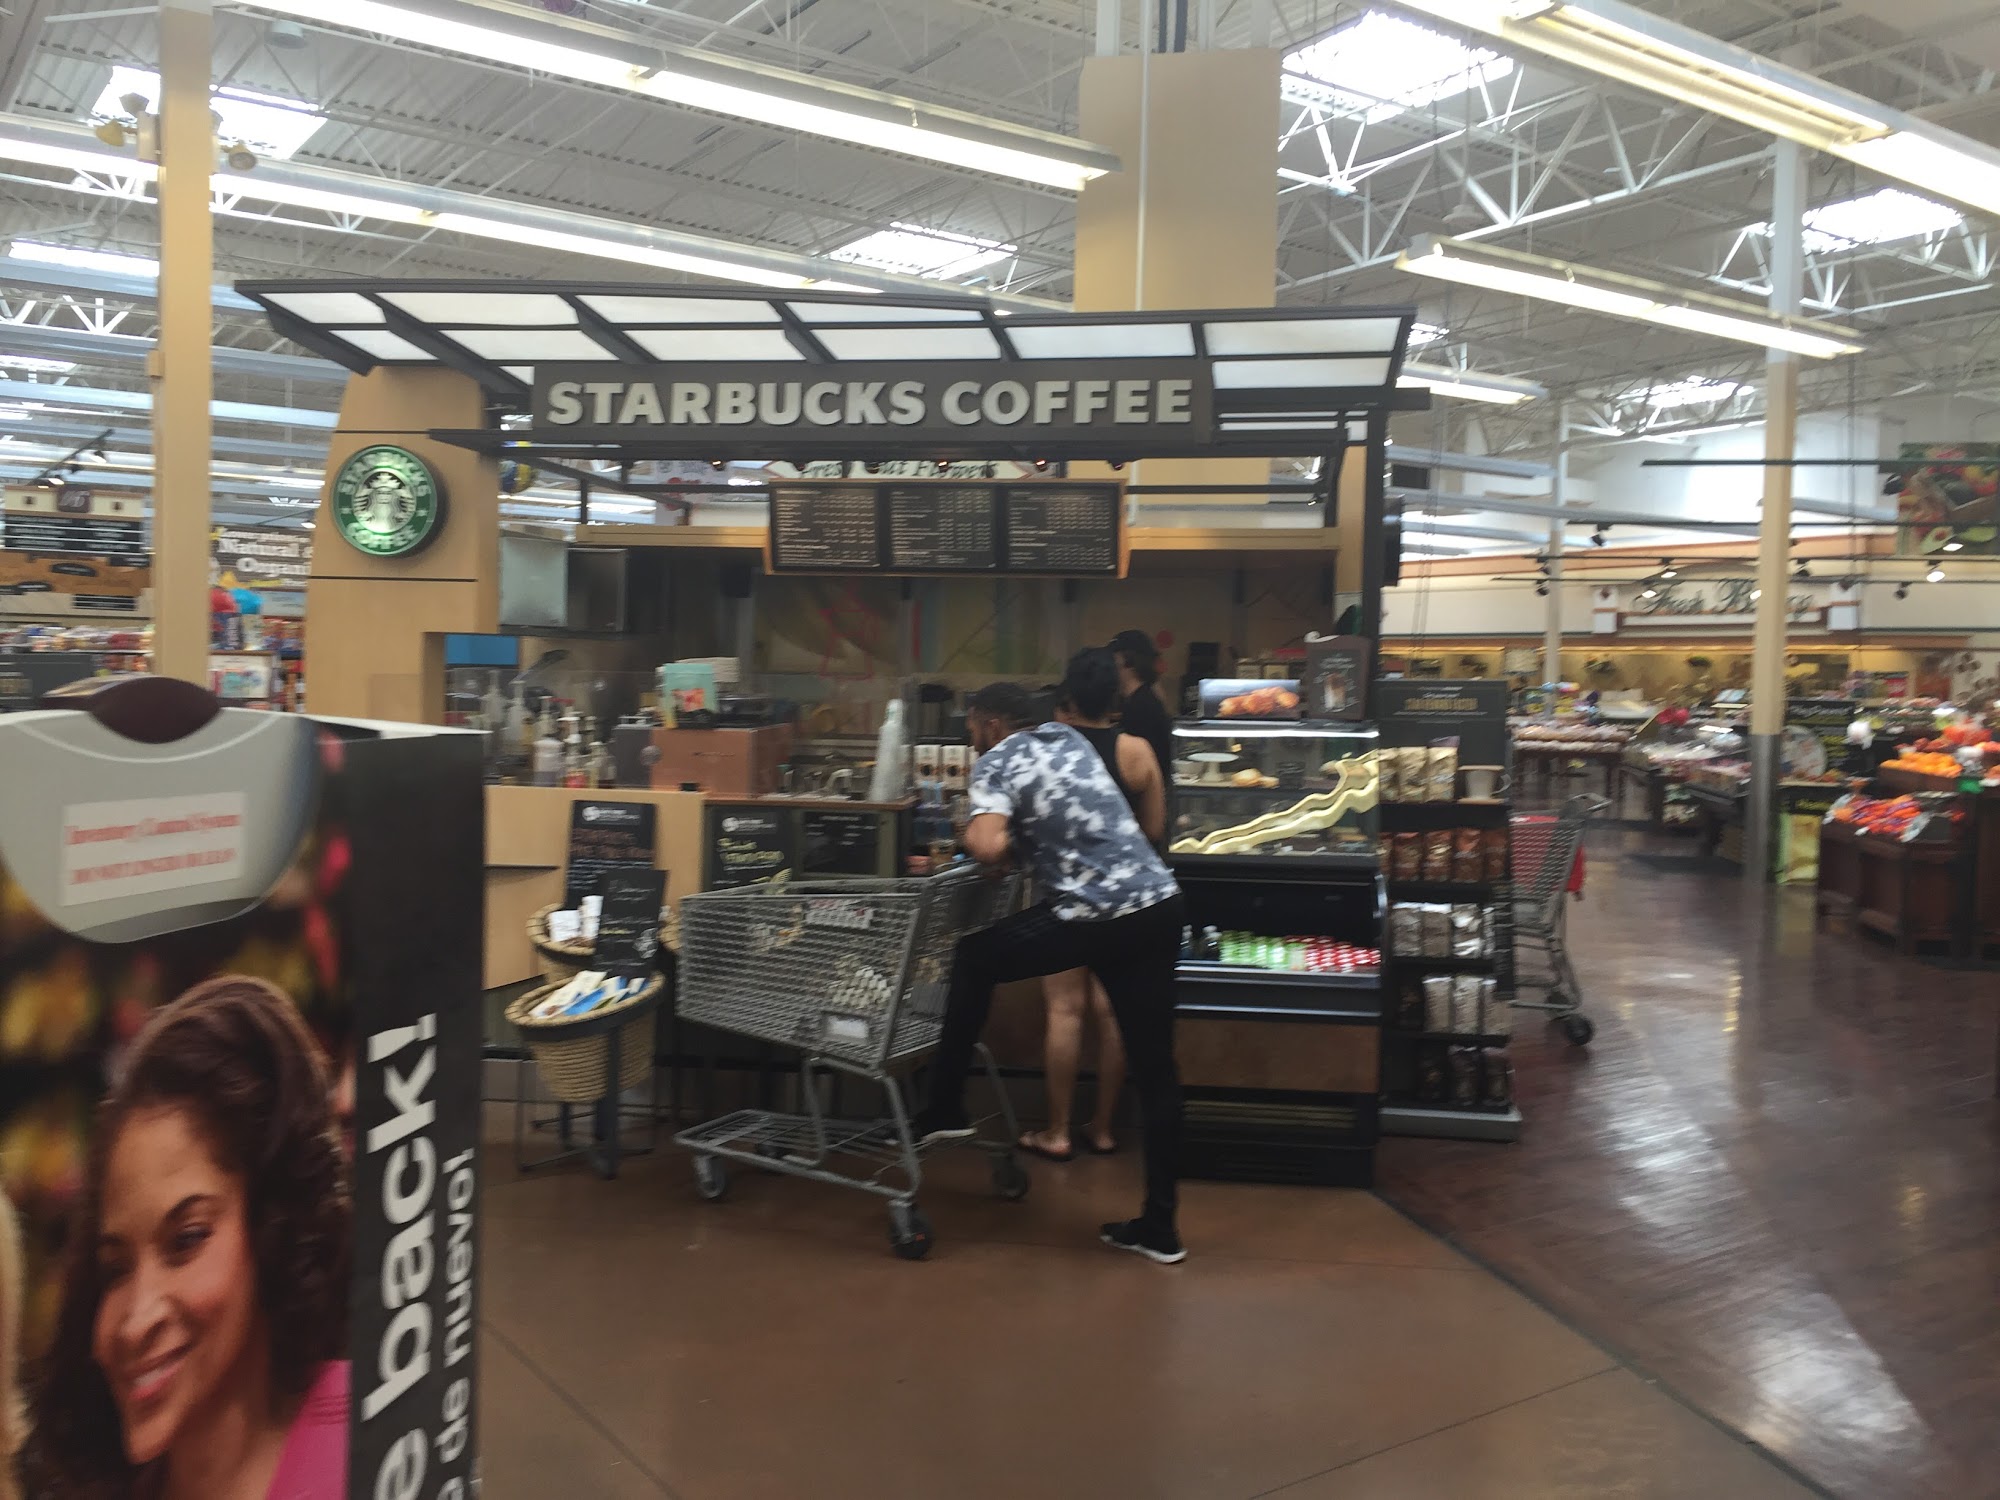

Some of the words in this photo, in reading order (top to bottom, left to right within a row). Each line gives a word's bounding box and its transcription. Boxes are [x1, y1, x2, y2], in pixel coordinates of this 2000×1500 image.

[546, 381, 926, 426] STARBUCKS
[940, 379, 1192, 426] COFFEE
[337, 450, 433, 498] STARBUCKS
[345, 521, 420, 551] COFFEE
[236, 557, 312, 578] Organi
[360, 1012, 437, 1424] back!
[442, 1147, 476, 1369] nuevo!
[433, 1376, 471, 1465] de
